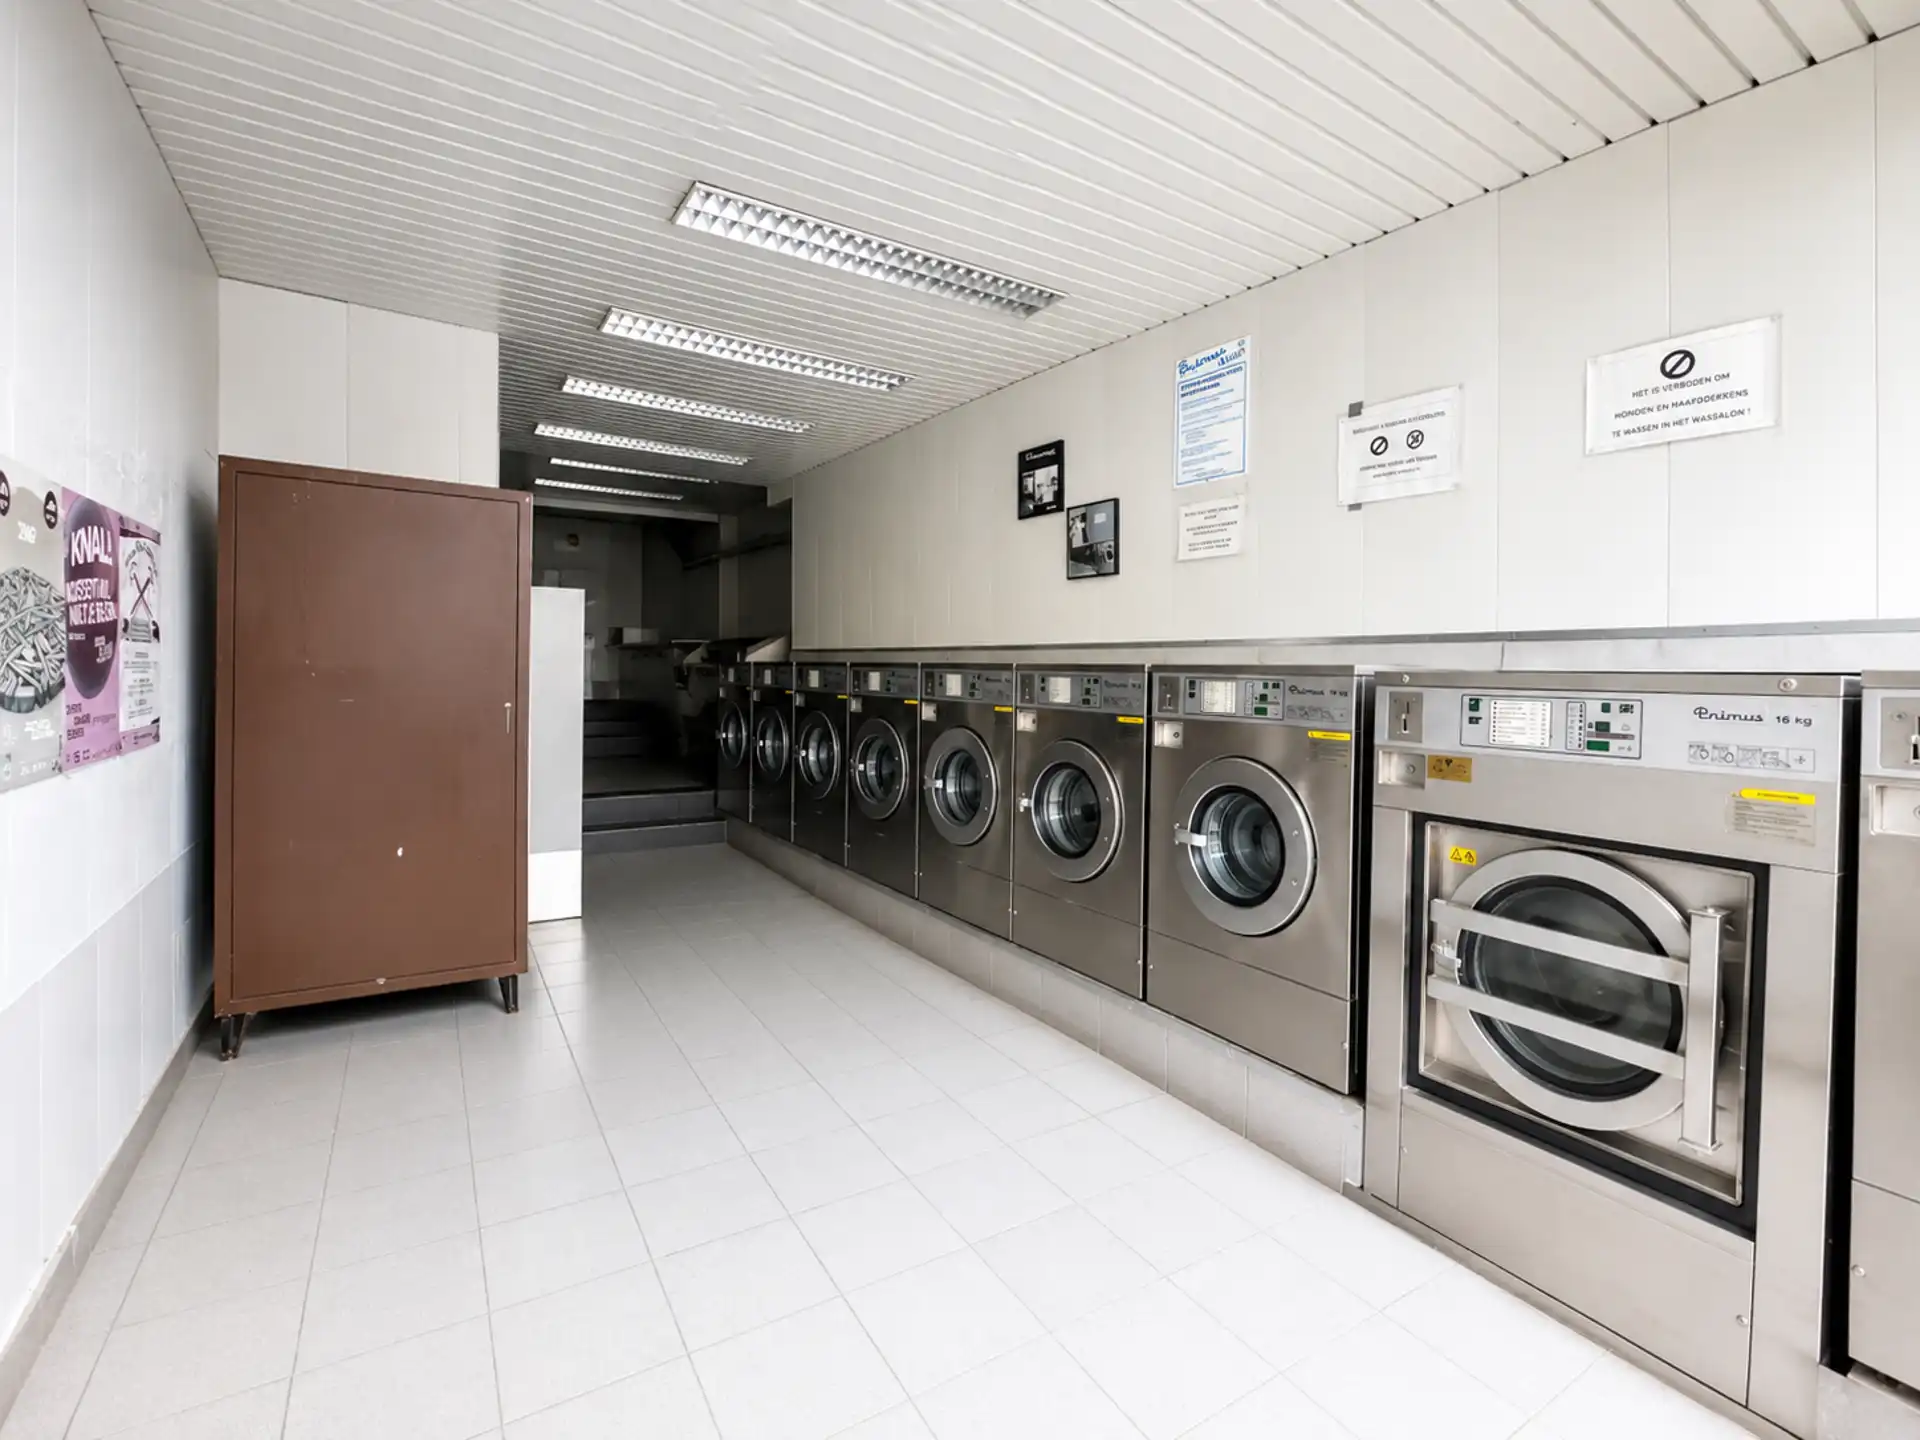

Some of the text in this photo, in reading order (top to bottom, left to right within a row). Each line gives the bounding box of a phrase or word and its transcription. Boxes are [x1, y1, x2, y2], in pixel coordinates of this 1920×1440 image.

[1631, 371, 1731, 399] HET IS VERBODEN OM
[1611, 429, 1621, 439] TE
[1623, 423, 1659, 436] WASSEN
[1660, 421, 1671, 429] IN
[1672, 416, 1690, 426] HET
[1691, 408, 1745, 424] WASSALON
[1614, 406, 1654, 419] HONDEN
[1656, 403, 1670, 412] EN
[70, 524, 113, 568] KNAL!
[1775, 714, 1790, 725] 16
[1794, 715, 1813, 728] kg
